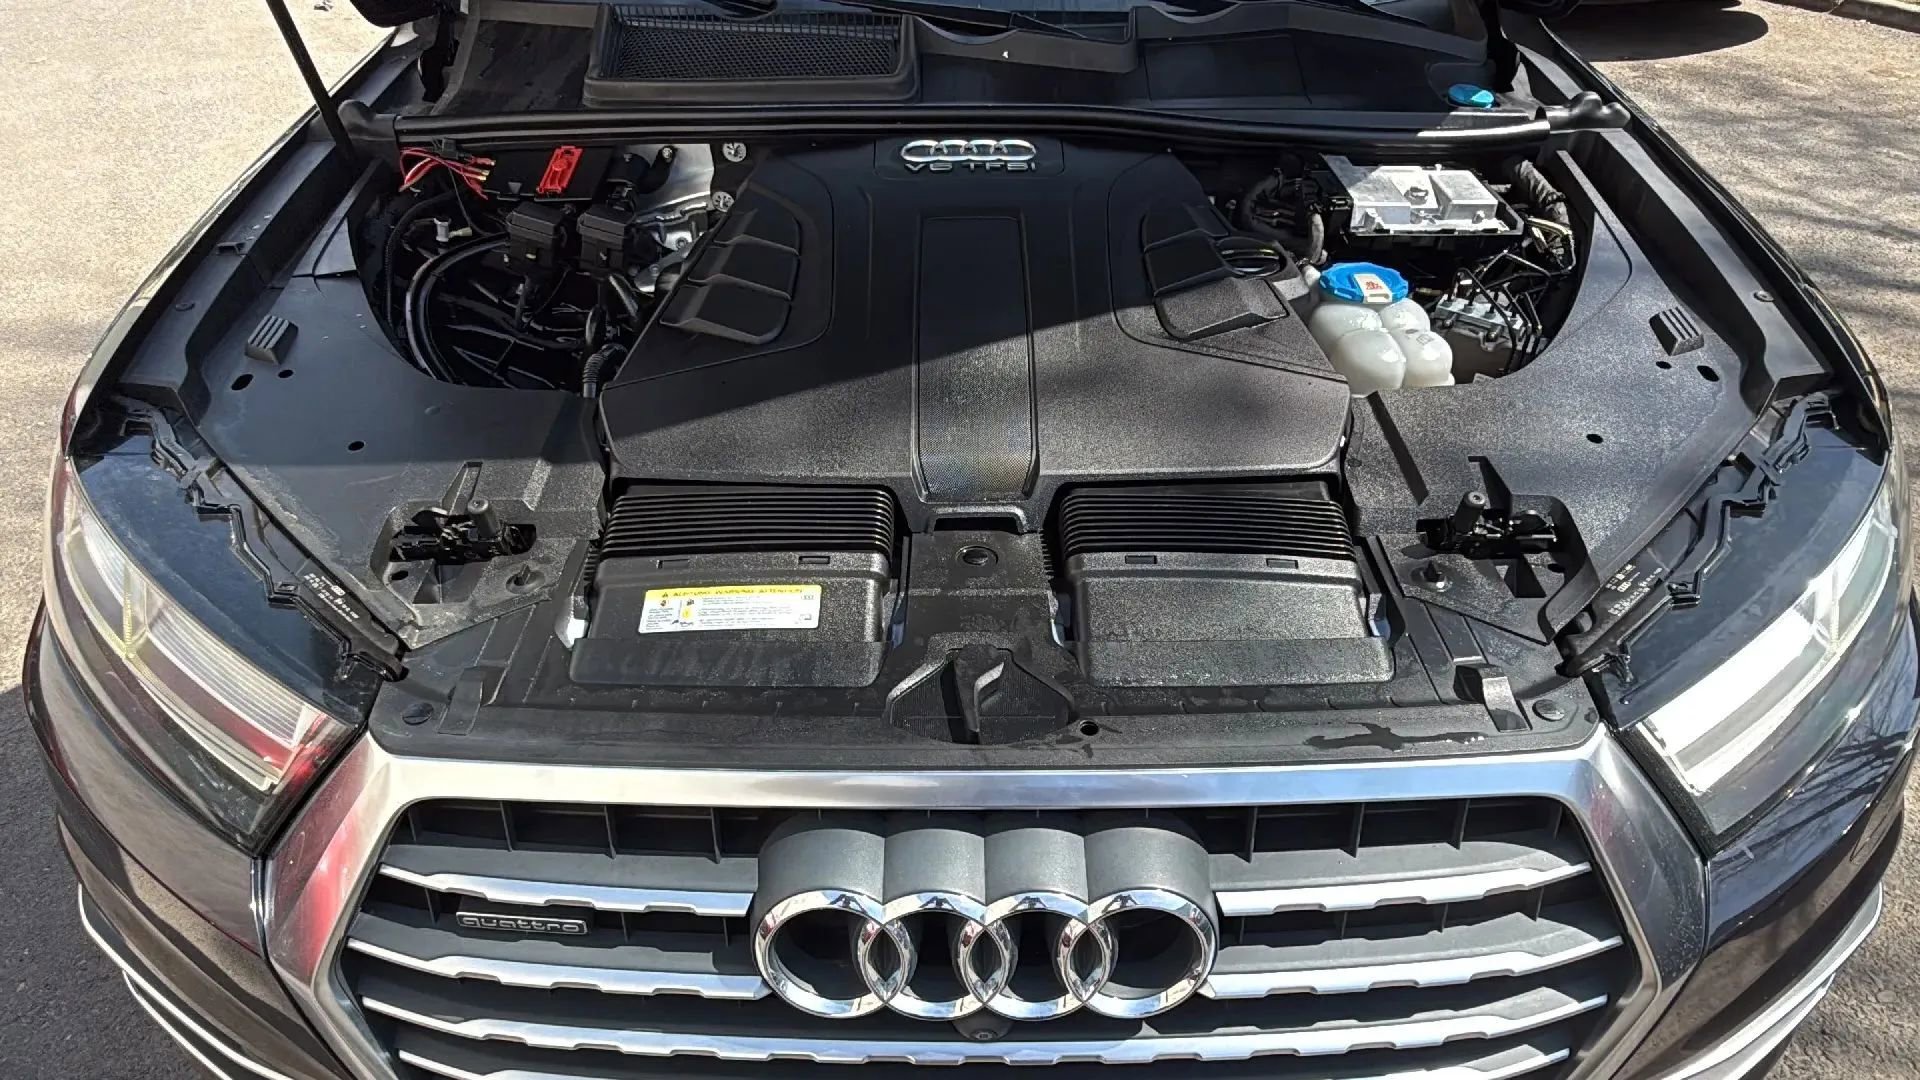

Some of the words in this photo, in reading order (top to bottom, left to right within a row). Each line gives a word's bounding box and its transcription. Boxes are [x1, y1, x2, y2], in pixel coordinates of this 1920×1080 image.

[905, 162, 952, 171] V6
[962, 162, 1036, 171] TFSI
[462, 917, 580, 932] quattro
